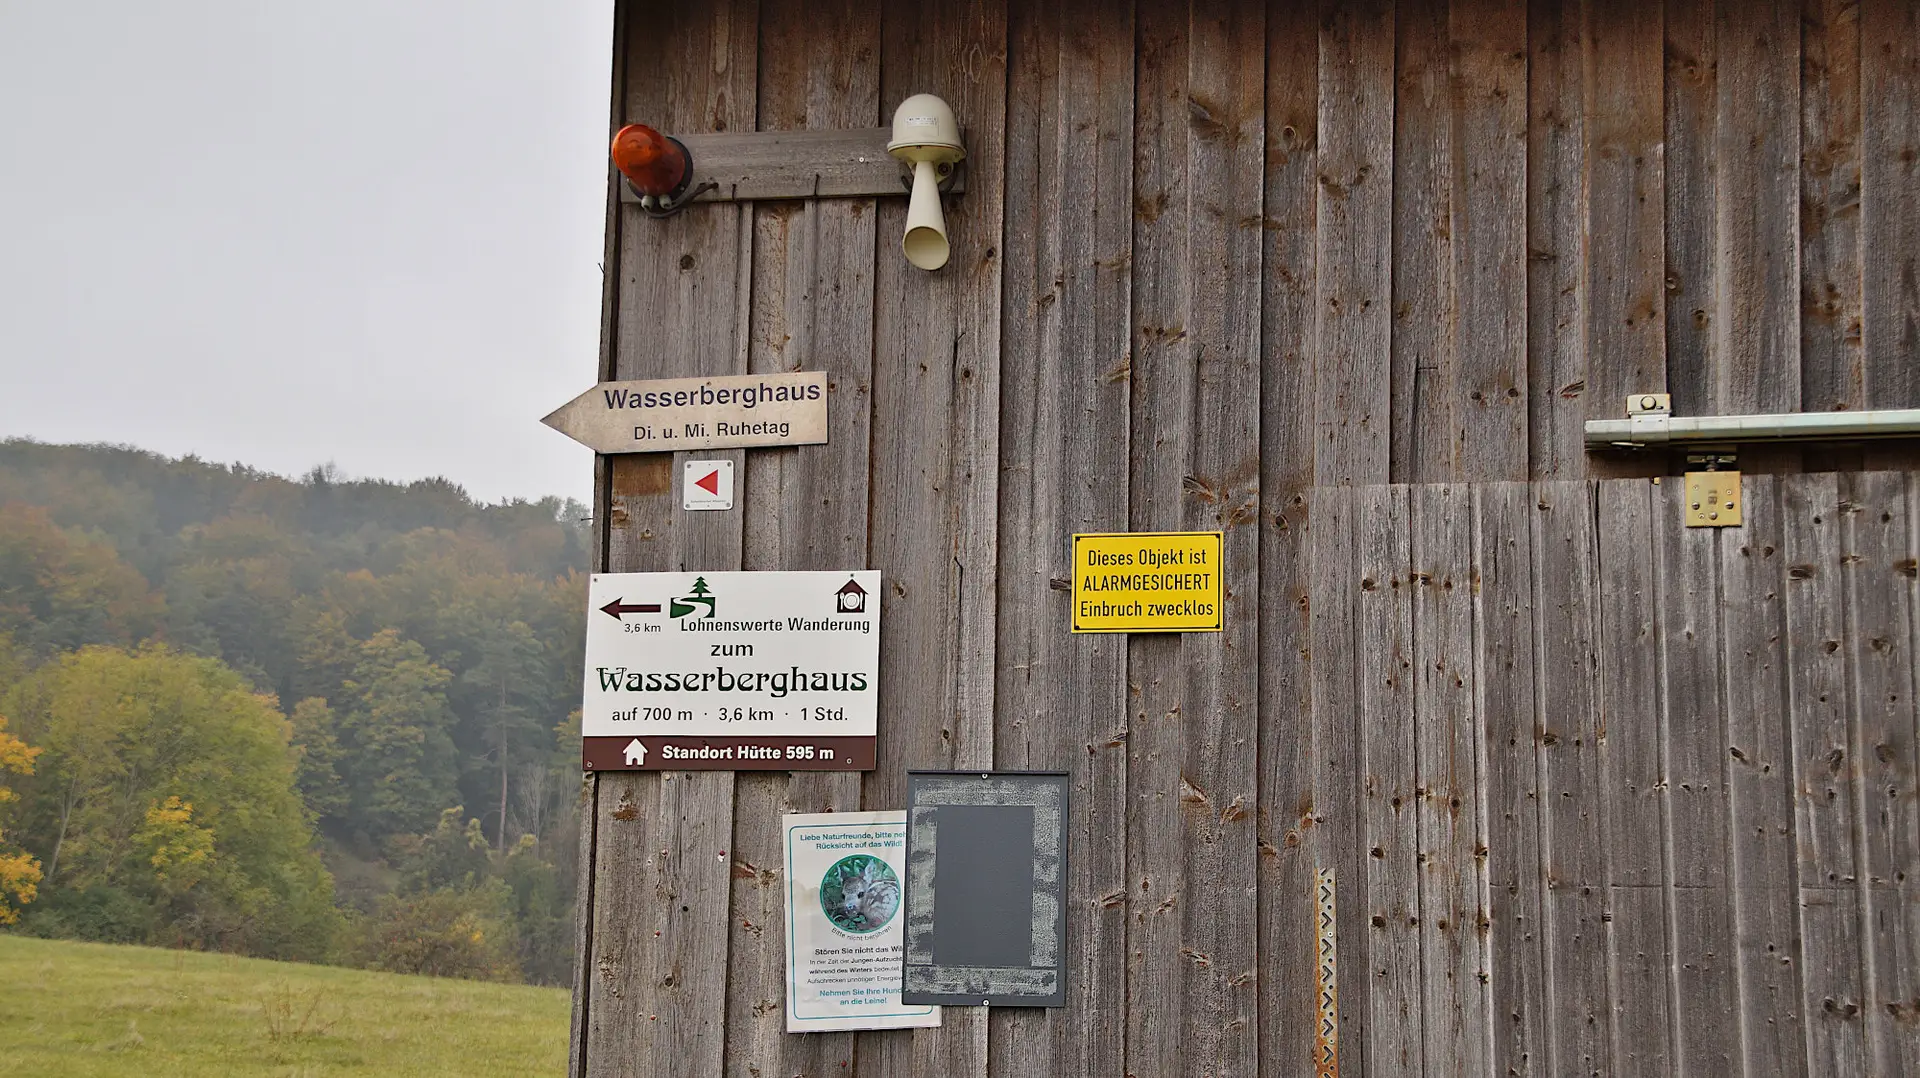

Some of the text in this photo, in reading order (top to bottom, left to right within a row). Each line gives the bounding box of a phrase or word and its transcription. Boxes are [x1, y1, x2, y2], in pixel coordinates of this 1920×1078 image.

[604, 382, 821, 409] Wasserberghaus
[634, 421, 790, 440] Di. u. Mi. Ruhetag
[1088, 548, 1207, 569] Dieses Objekt ist
[1083, 573, 1211, 591] ALARMGESICHERT
[1080, 599, 1214, 617] Einbruch zwecklos
[624, 622, 661, 634] 3,6 km
[681, 617, 870, 634] Lohnenswerte Wanderung
[711, 643, 754, 657] zum
[596, 666, 867, 698] Wasserberghaus
[612, 707, 848, 723] auf 700 m 3,6 km 1 Std.
[662, 744, 834, 760] Standort Hütte 595 m
[822, 832, 874, 840] Naturfreunde,
[875, 831, 892, 839] bitte
[854, 841, 867, 849] auf
[815, 948, 840, 956] Stören
[854, 946, 874, 954] nicht
[875, 945, 889, 953] das
[866, 987, 881, 995] Ihre
[850, 998, 863, 1006] die
